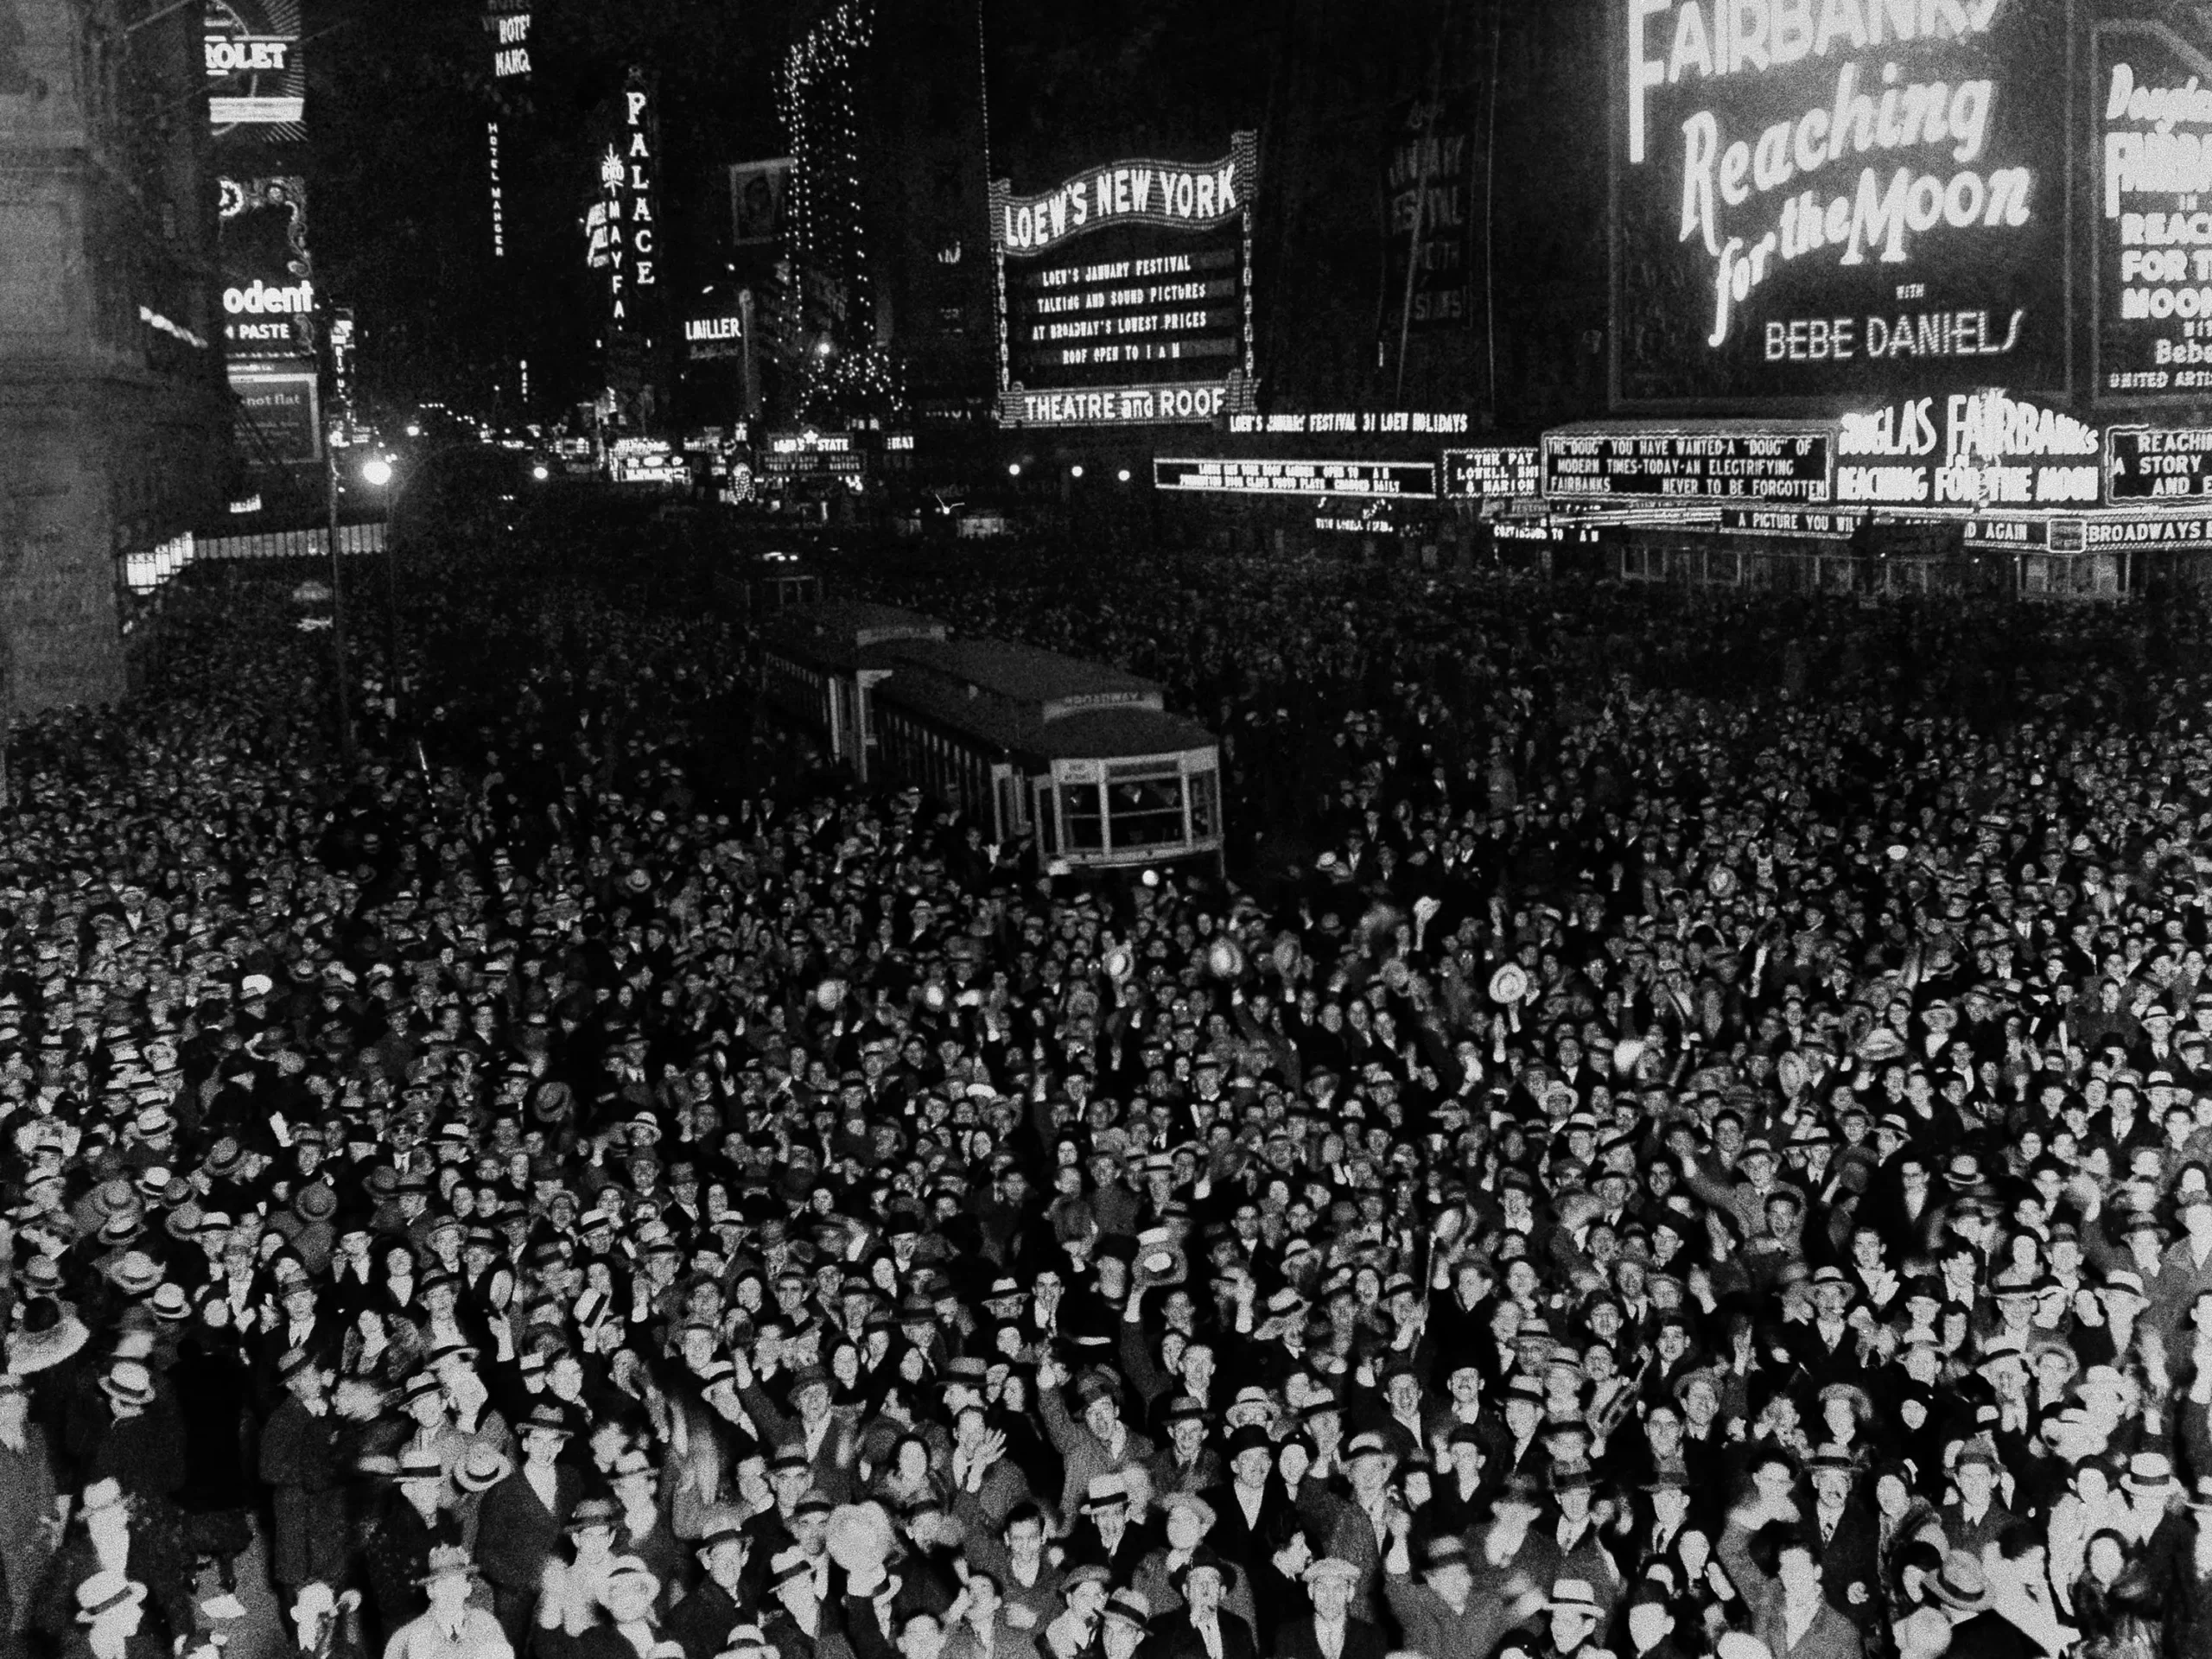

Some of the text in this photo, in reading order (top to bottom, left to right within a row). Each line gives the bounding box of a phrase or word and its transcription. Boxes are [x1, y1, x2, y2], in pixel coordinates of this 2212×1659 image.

[487, 122, 500, 181] HOTEL
[1678, 62, 1994, 256] Reaching
[626, 92, 655, 284] PALACE
[1004, 163, 1236, 248] LOEW'S NEW YORK
[608, 200, 626, 332] MAYFA
[1042, 255, 1192, 287] LOEW'S JANUARY FESTIVAL
[1708, 167, 2031, 346] for the Moon
[2121, 250, 2188, 282] FOR
[223, 280, 315, 314] odent
[1037, 283, 1206, 314] TALKING AND SOUND PICTURES
[1896, 284, 1925, 299] WITH
[238, 324, 290, 340] PASTE
[1033, 311, 1207, 341] AT BROADWAY'S LOWEST PRICES
[1765, 308, 2024, 361] BEBE DANIELS
[1063, 348, 1088, 365] ROOF
[1093, 346, 1119, 363] OPEN
[1125, 345, 1139, 360] TO
[1159, 346, 1166, 359] A
[1172, 342, 1181, 359] M
[1025, 388, 1226, 421] THEATRE and ROOF
[1310, 413, 1357, 432] FESTIVAL
[1413, 413, 1468, 433] HOLIDAYS
[1947, 394, 2100, 455] FAIRBANKS
[817, 438, 849, 452] STATE
[1611, 439, 1634, 455] YOU
[1640, 439, 1669, 455] HAVE
[1796, 439, 1813, 455] OF
[1557, 459, 1599, 474] MODERN
[1708, 459, 1795, 475] ELECTRIFYING
[2114, 454, 2202, 476] A STORY
[1551, 476, 1826, 498] FAIRBANKS NEVER TO BE FORGOTTEN
[1935, 467, 1980, 502] FOR
[1987, 467, 2032, 502] THE
[2036, 467, 2100, 502] MOON
[2152, 476, 2190, 496] AND
[1738, 512, 1746, 527] A
[1752, 512, 1798, 529] PICTURE
[1805, 514, 1829, 531] YOU
[1985, 522, 2028, 540] AGAIN
[2088, 521, 2202, 543] BROADWAYS
